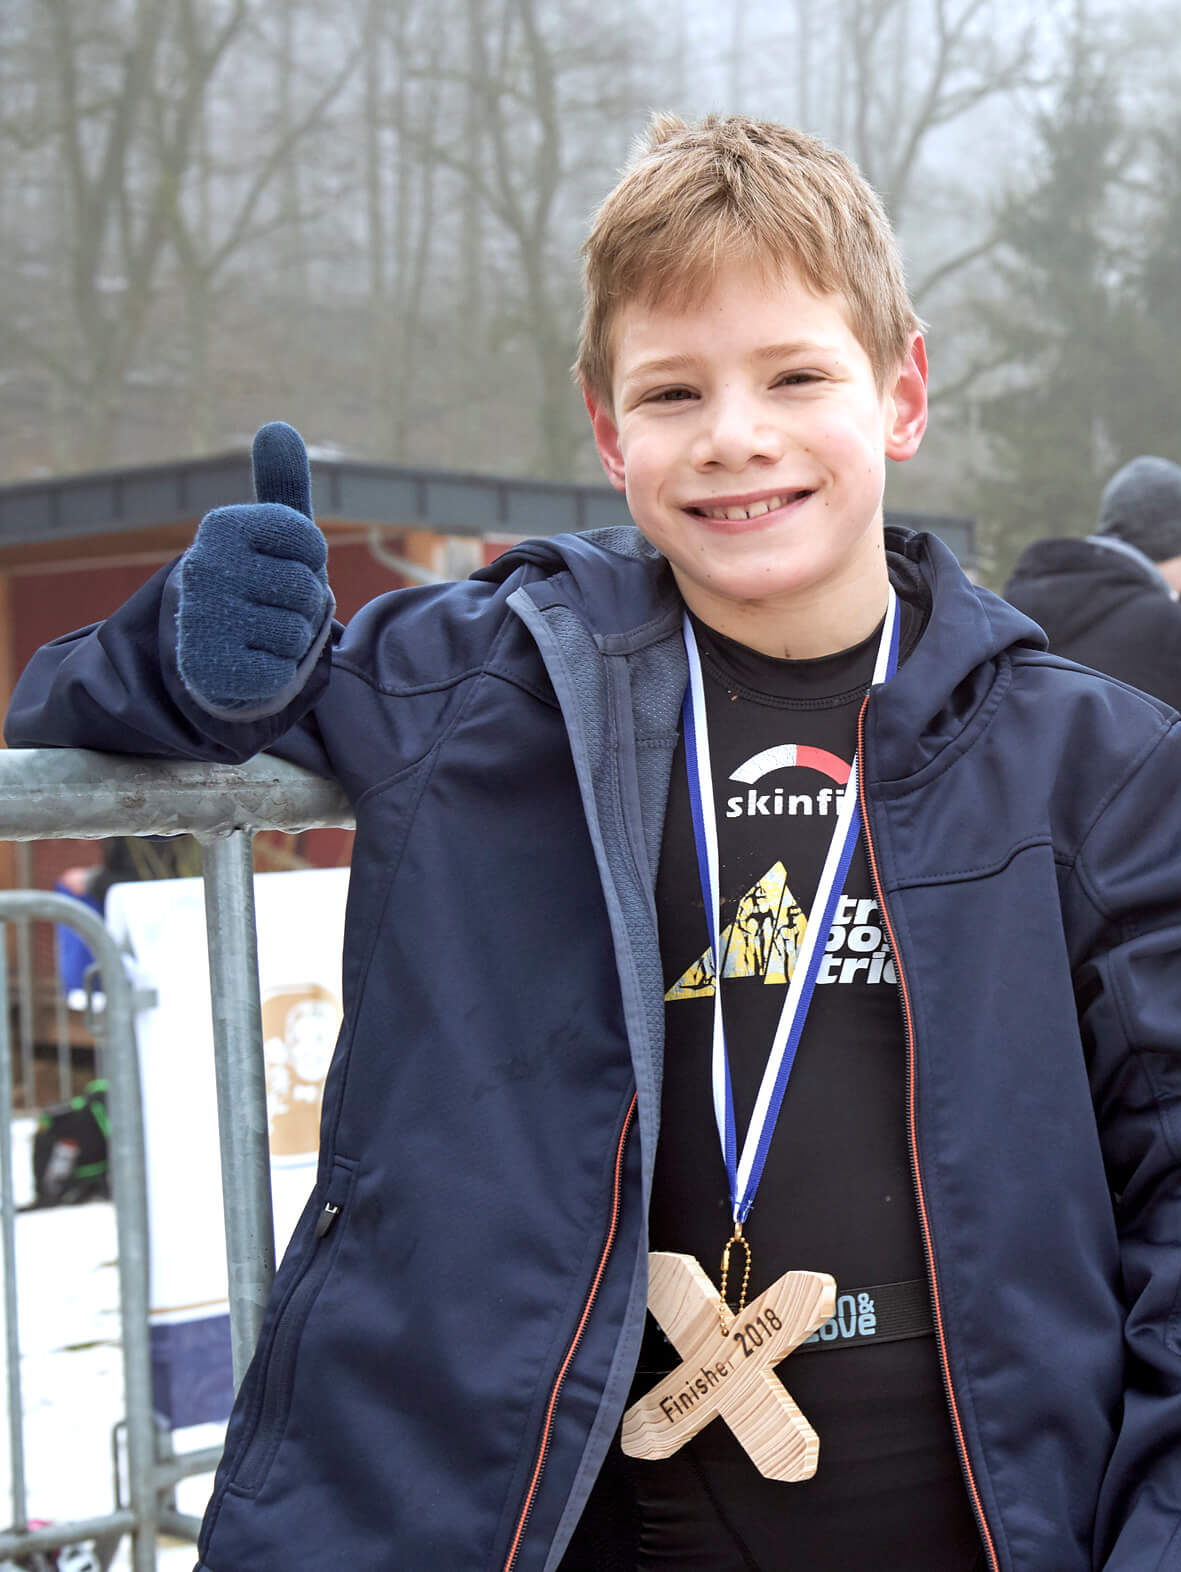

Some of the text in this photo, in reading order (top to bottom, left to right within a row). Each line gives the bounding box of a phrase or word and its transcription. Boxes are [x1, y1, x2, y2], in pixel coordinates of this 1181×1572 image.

[726, 788, 844, 818] skinfi
[831, 894, 880, 925] tr
[734, 1308, 782, 1358] 2018
